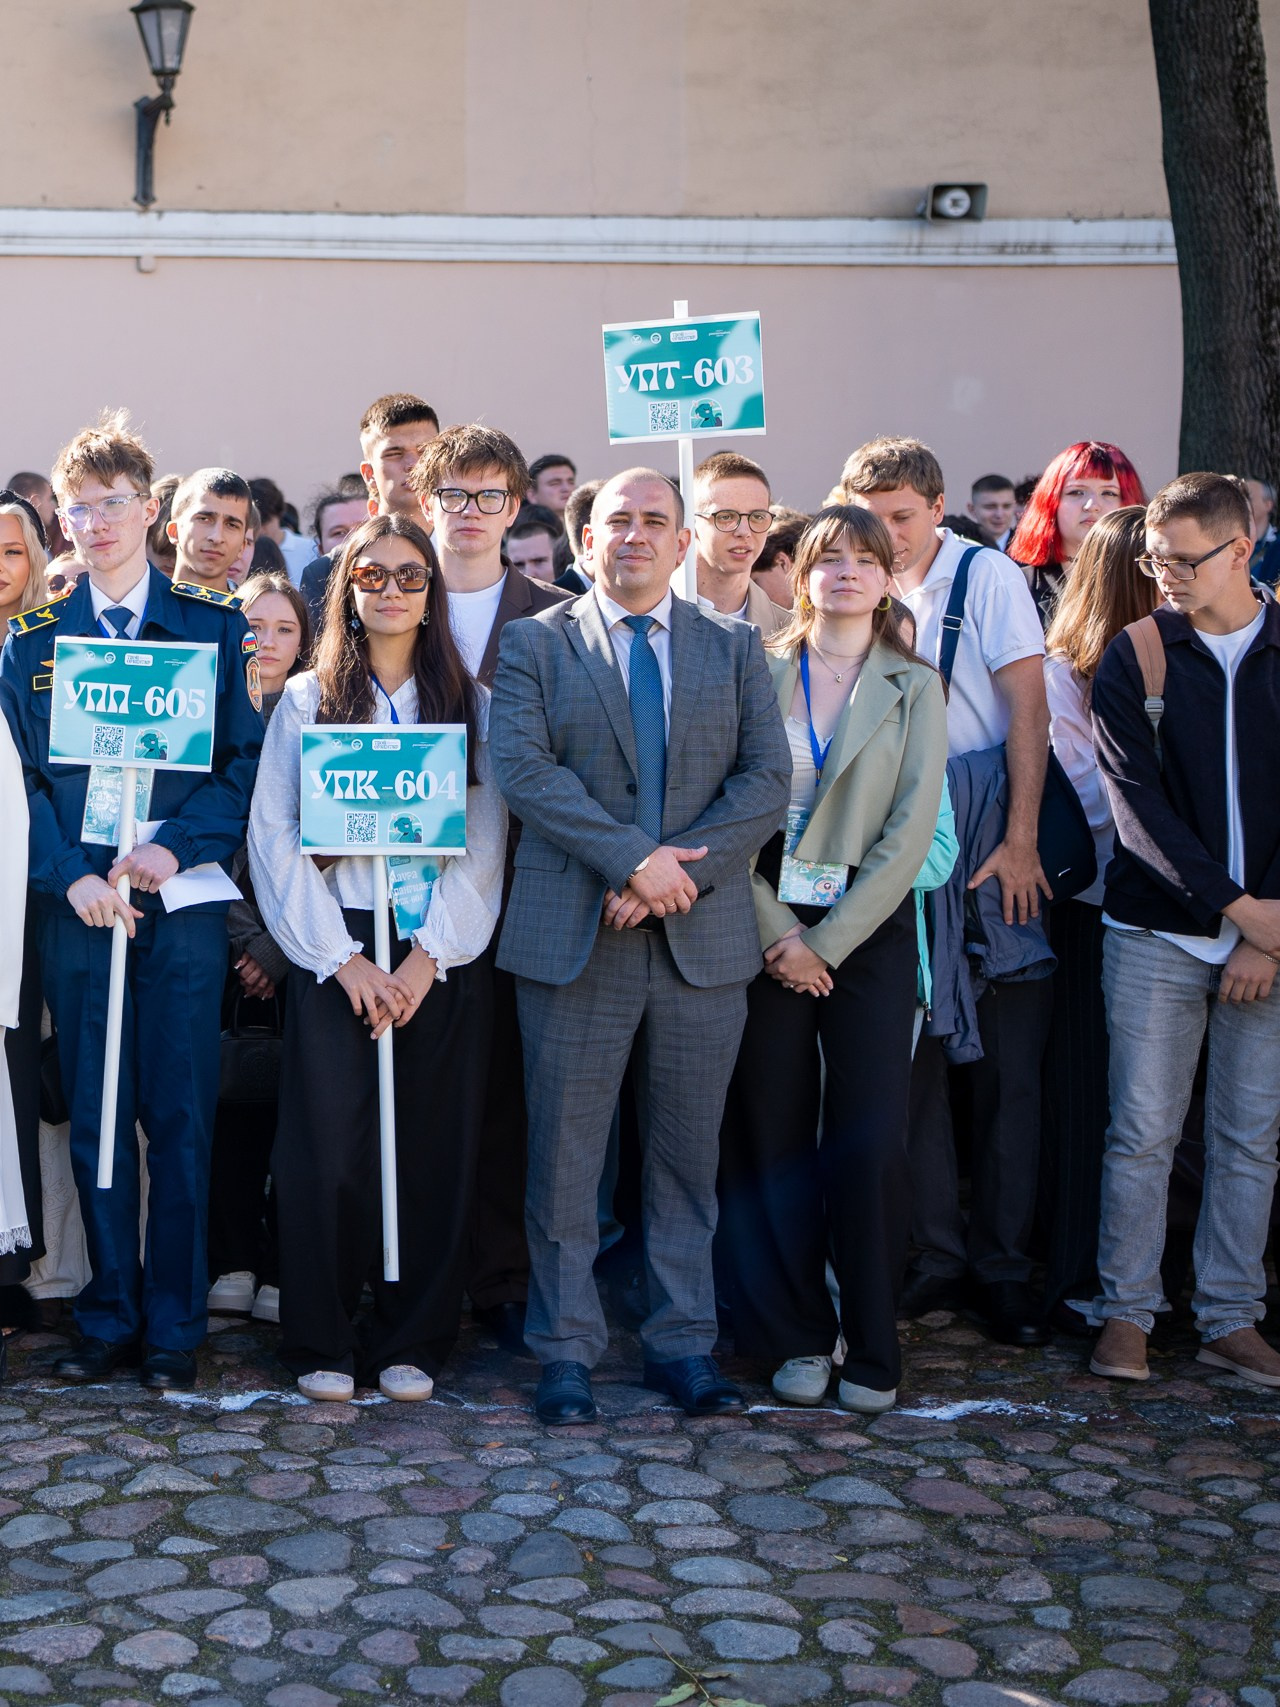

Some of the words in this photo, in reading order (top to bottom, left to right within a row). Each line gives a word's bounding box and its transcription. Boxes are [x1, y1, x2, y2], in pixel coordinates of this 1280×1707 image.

[614, 355, 755, 393] УПТ-603
[63, 681, 206, 719] УПП-605
[309, 770, 460, 801] УПК-604
